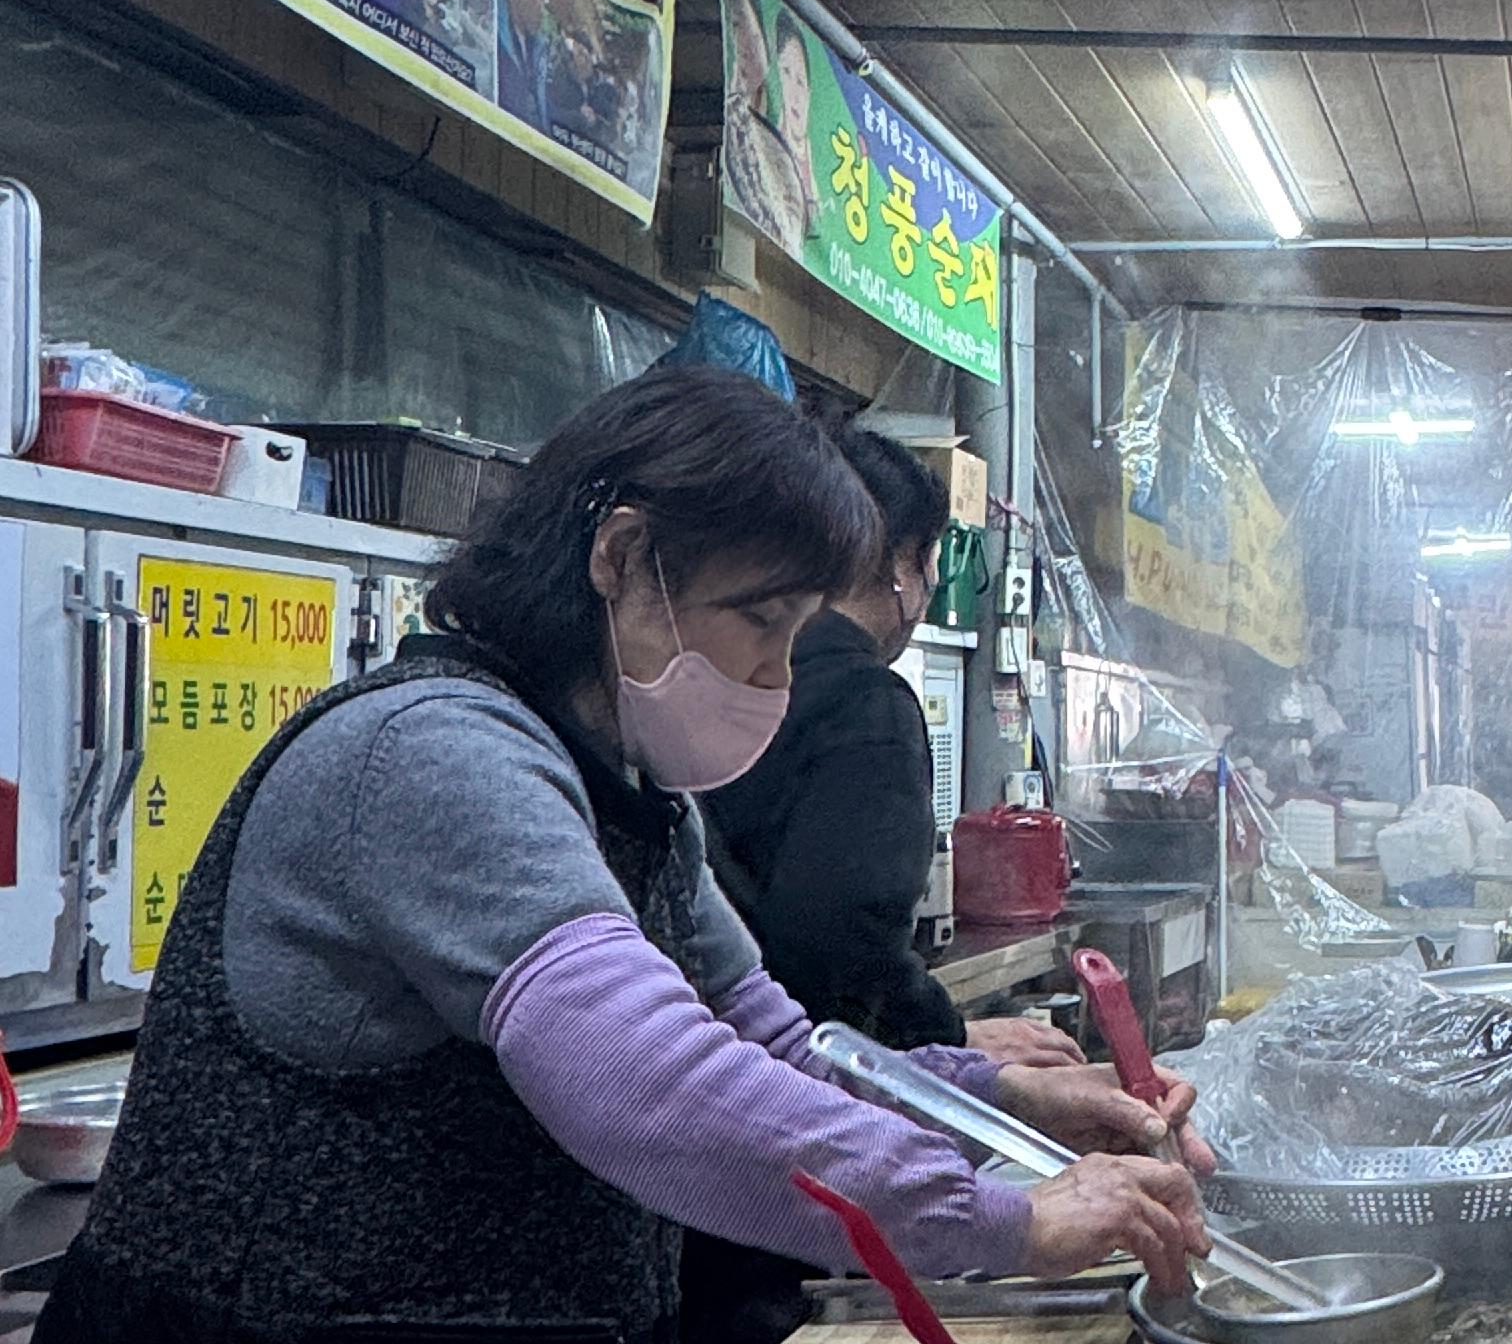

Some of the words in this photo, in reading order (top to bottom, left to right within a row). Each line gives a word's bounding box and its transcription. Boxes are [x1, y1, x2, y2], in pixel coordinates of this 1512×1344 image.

[152, 584, 257, 643] 머릿고기
[270, 598, 328, 651] 15,000
[150, 680, 257, 732] 모듬포장
